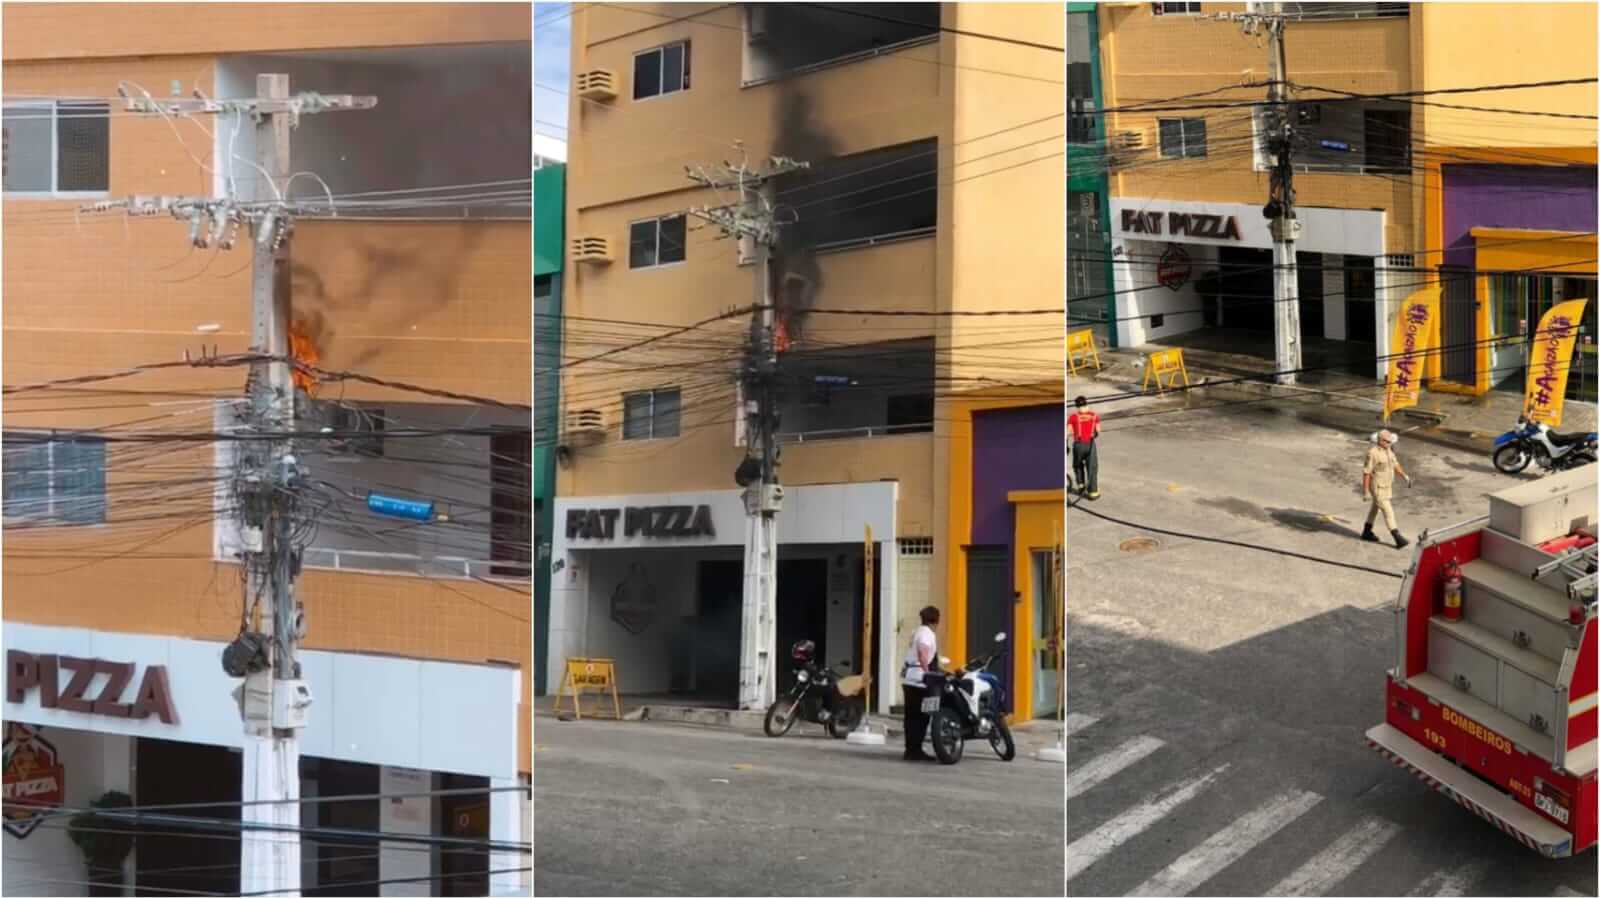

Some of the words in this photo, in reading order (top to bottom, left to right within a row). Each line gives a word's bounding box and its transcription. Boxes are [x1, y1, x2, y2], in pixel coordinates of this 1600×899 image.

[1121, 209, 1163, 234] FAT
[1168, 212, 1242, 240] PIZZA
[566, 508, 621, 539] FAT
[624, 505, 716, 538] PIZZA
[7, 649, 181, 725] PIZZA
[1424, 728, 1446, 748] 193
[1442, 706, 1512, 755] BOMBEIROS
